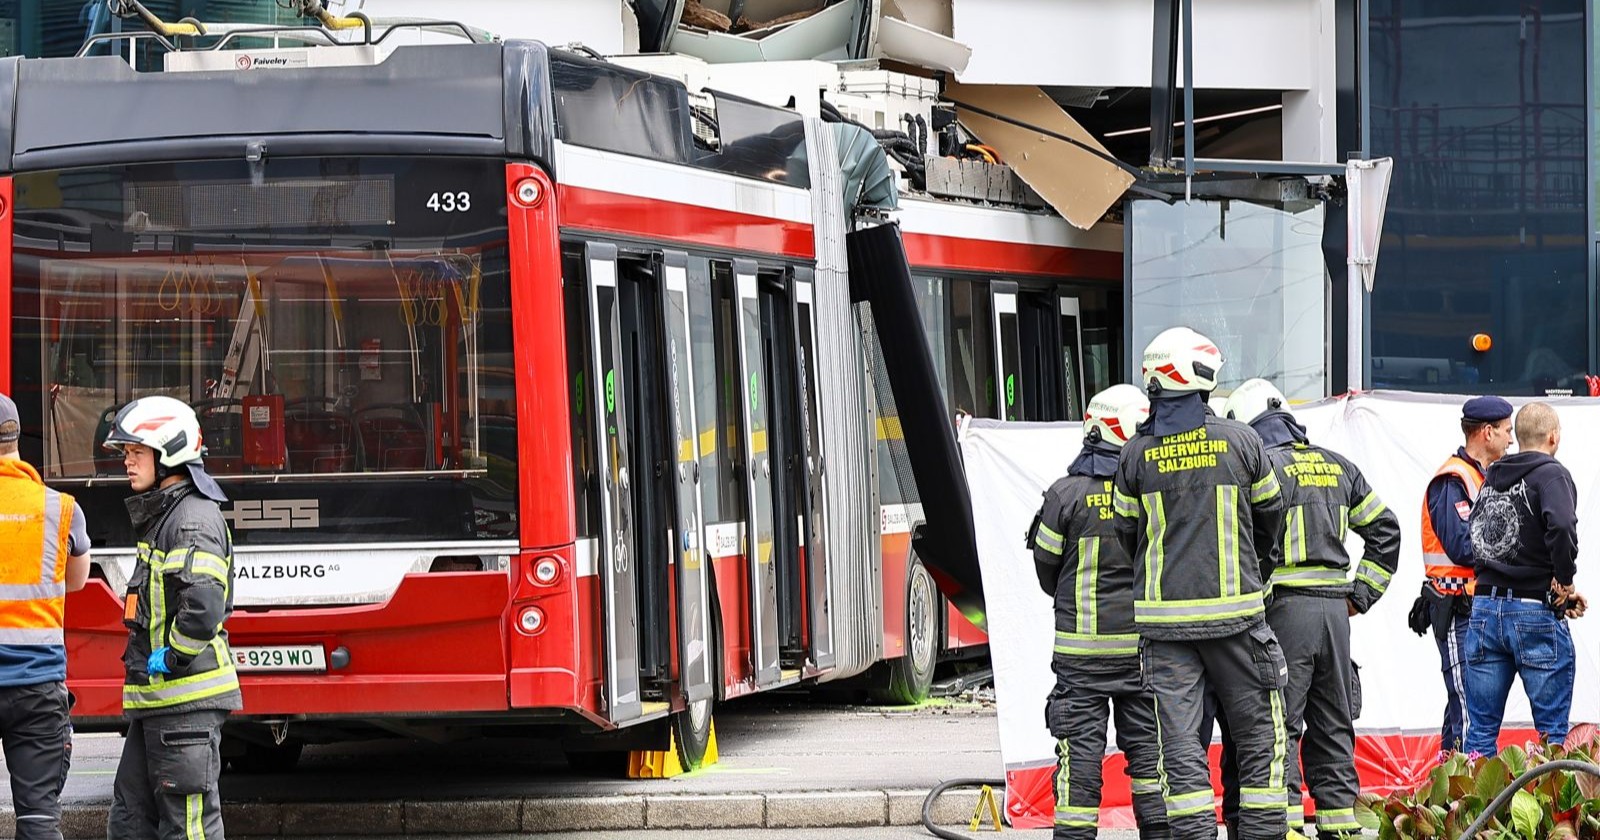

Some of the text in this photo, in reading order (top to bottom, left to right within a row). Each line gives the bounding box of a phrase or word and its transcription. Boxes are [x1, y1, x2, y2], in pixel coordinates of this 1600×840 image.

[253, 57, 287, 65] Faiveley
[426, 191, 471, 212] 433
[1144, 440, 1228, 462] FEUERWEHR
[1157, 454, 1217, 473] SALZBURG
[1283, 463, 1343, 478] FEUERWEHR
[248, 650, 284, 667] 929
[286, 649, 313, 666] WO
